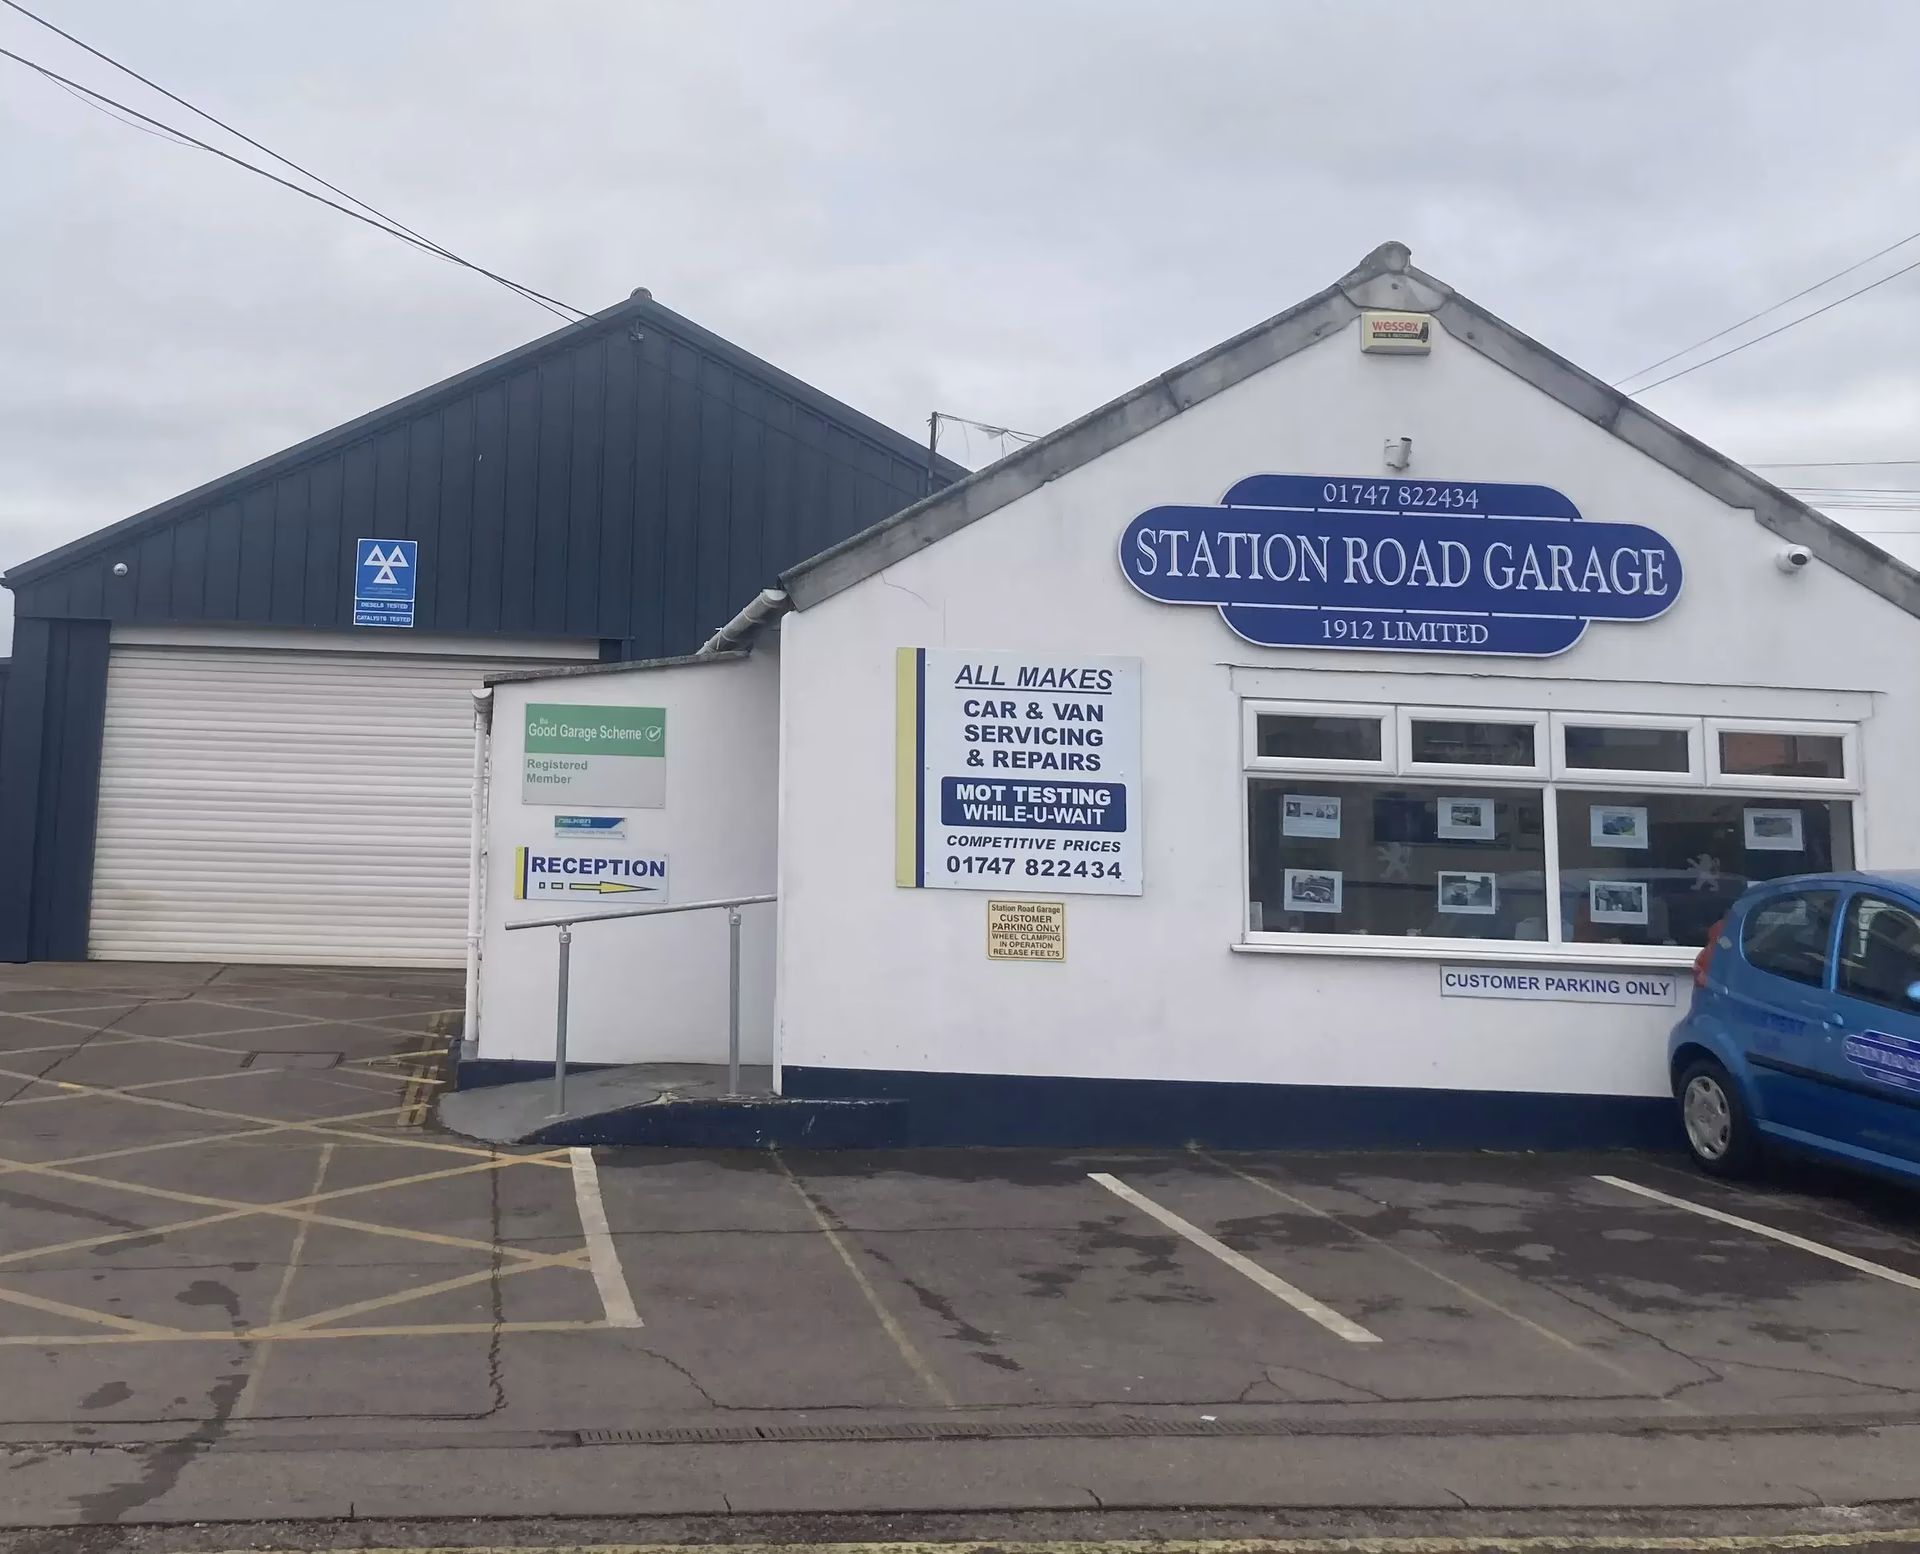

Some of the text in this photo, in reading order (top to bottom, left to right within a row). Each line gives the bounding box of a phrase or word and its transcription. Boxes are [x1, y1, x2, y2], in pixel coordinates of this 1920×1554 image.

[1372, 321, 1419, 332] wessex
[1322, 482, 1479, 510] 01747 822434
[1135, 526, 1669, 596] STATION ROAD GARAGE
[1321, 618, 1489, 645] 1912 LIMITED
[955, 664, 1113, 690] ALL MAKES
[539, 717, 549, 725] the
[963, 700, 1104, 722] CAR & VAN
[528, 722, 642, 742] Good Garage Scheme
[964, 724, 1104, 747] SERVICING
[527, 758, 588, 771] Registered
[966, 749, 1102, 772] & REPAIRS
[526, 773, 572, 784] Member
[956, 784, 1111, 806] MOT TESTING
[963, 804, 1105, 825] WHILE-U-WAIT
[946, 835, 1121, 853] COMPETITIVE PRICES
[531, 856, 665, 877] RECEPTION
[946, 855, 1122, 879] 01747 822434
[991, 904, 1016, 912] Station
[1036, 906, 1060, 914] Garage
[1000, 914, 1052, 923] CUSTOMER
[992, 923, 1060, 932] PARKING ONLY
[1009, 941, 1053, 949] OPERATION
[1020, 934, 1060, 942] CLAMPING
[993, 948, 1028, 956] RELEASE
[1445, 974, 1670, 996] CUSTOMER PARKING ONLY
